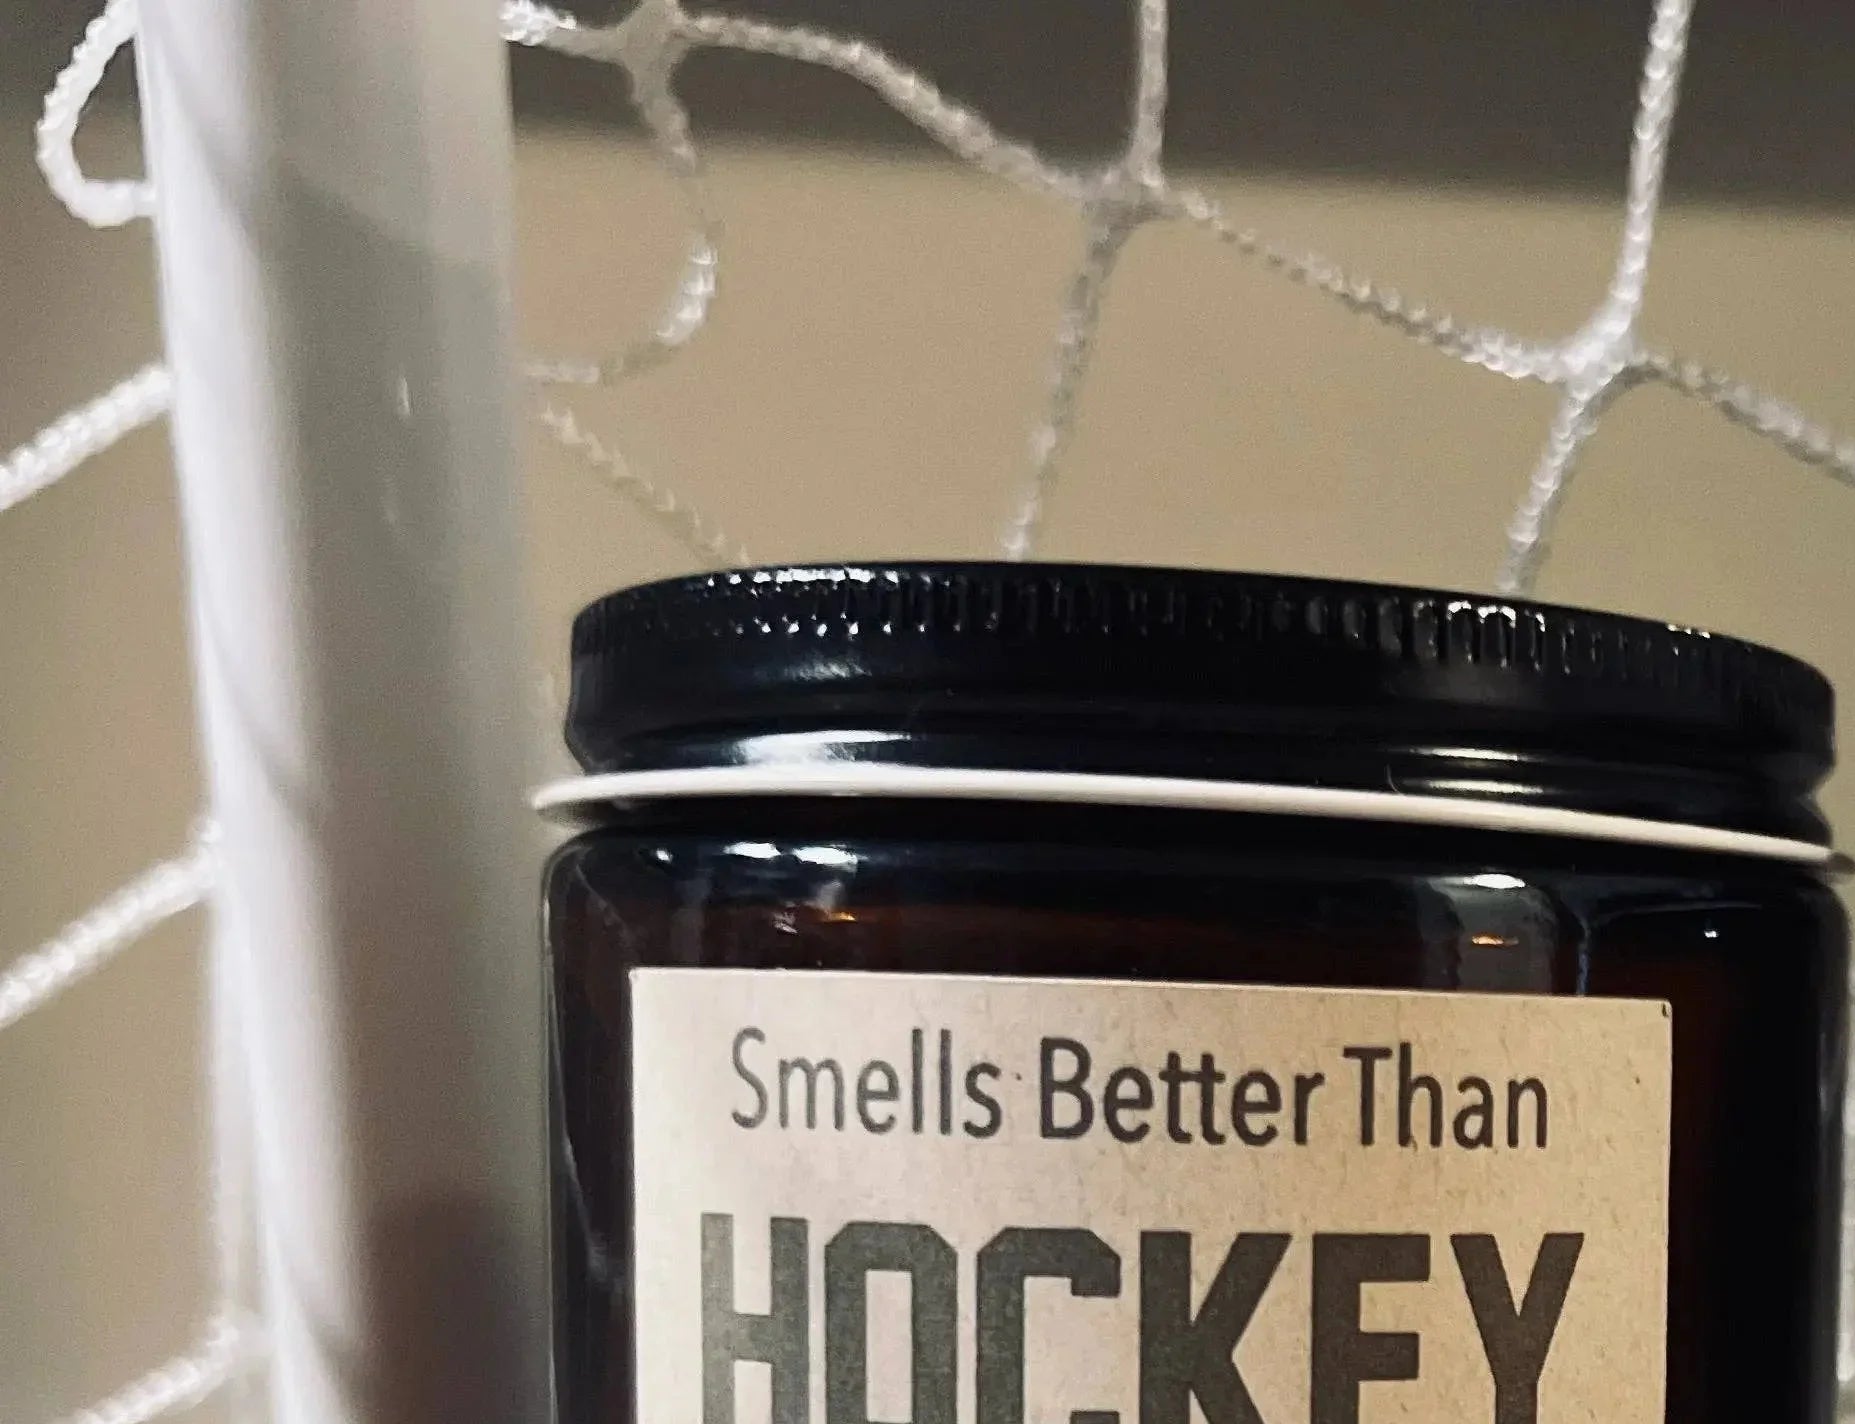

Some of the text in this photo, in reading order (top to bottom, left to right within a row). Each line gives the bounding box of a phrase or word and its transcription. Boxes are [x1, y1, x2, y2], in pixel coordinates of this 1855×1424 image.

[732, 1028, 1547, 1150] Smells Better Than
